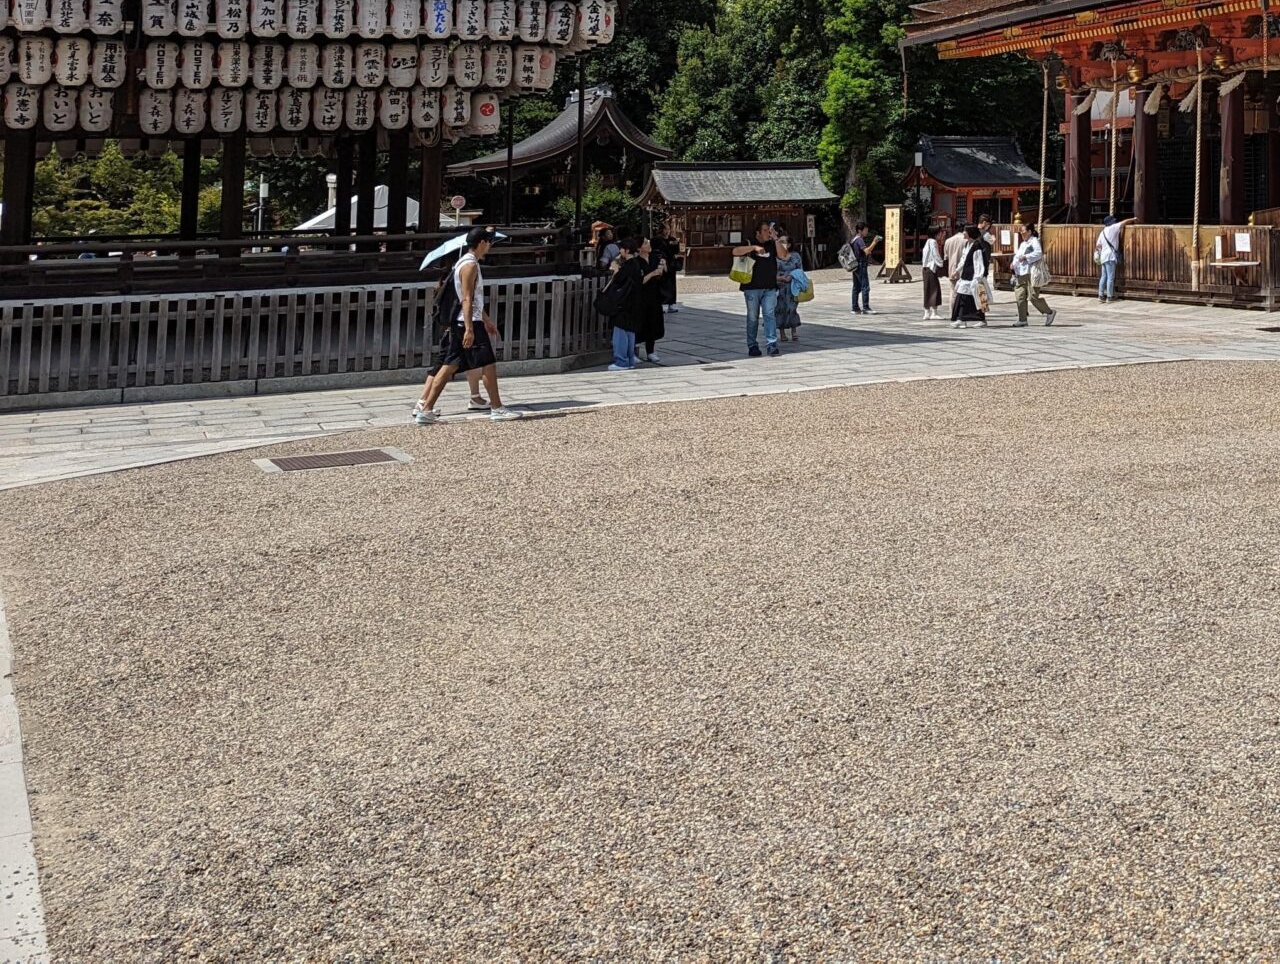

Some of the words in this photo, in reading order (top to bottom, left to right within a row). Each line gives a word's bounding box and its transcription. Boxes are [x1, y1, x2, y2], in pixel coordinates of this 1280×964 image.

[156, 44, 165, 84] NOSTER
[194, 43, 202, 84] NOSTER
[53, 86, 68, 124] おいと
[88, 86, 103, 124] おいと
